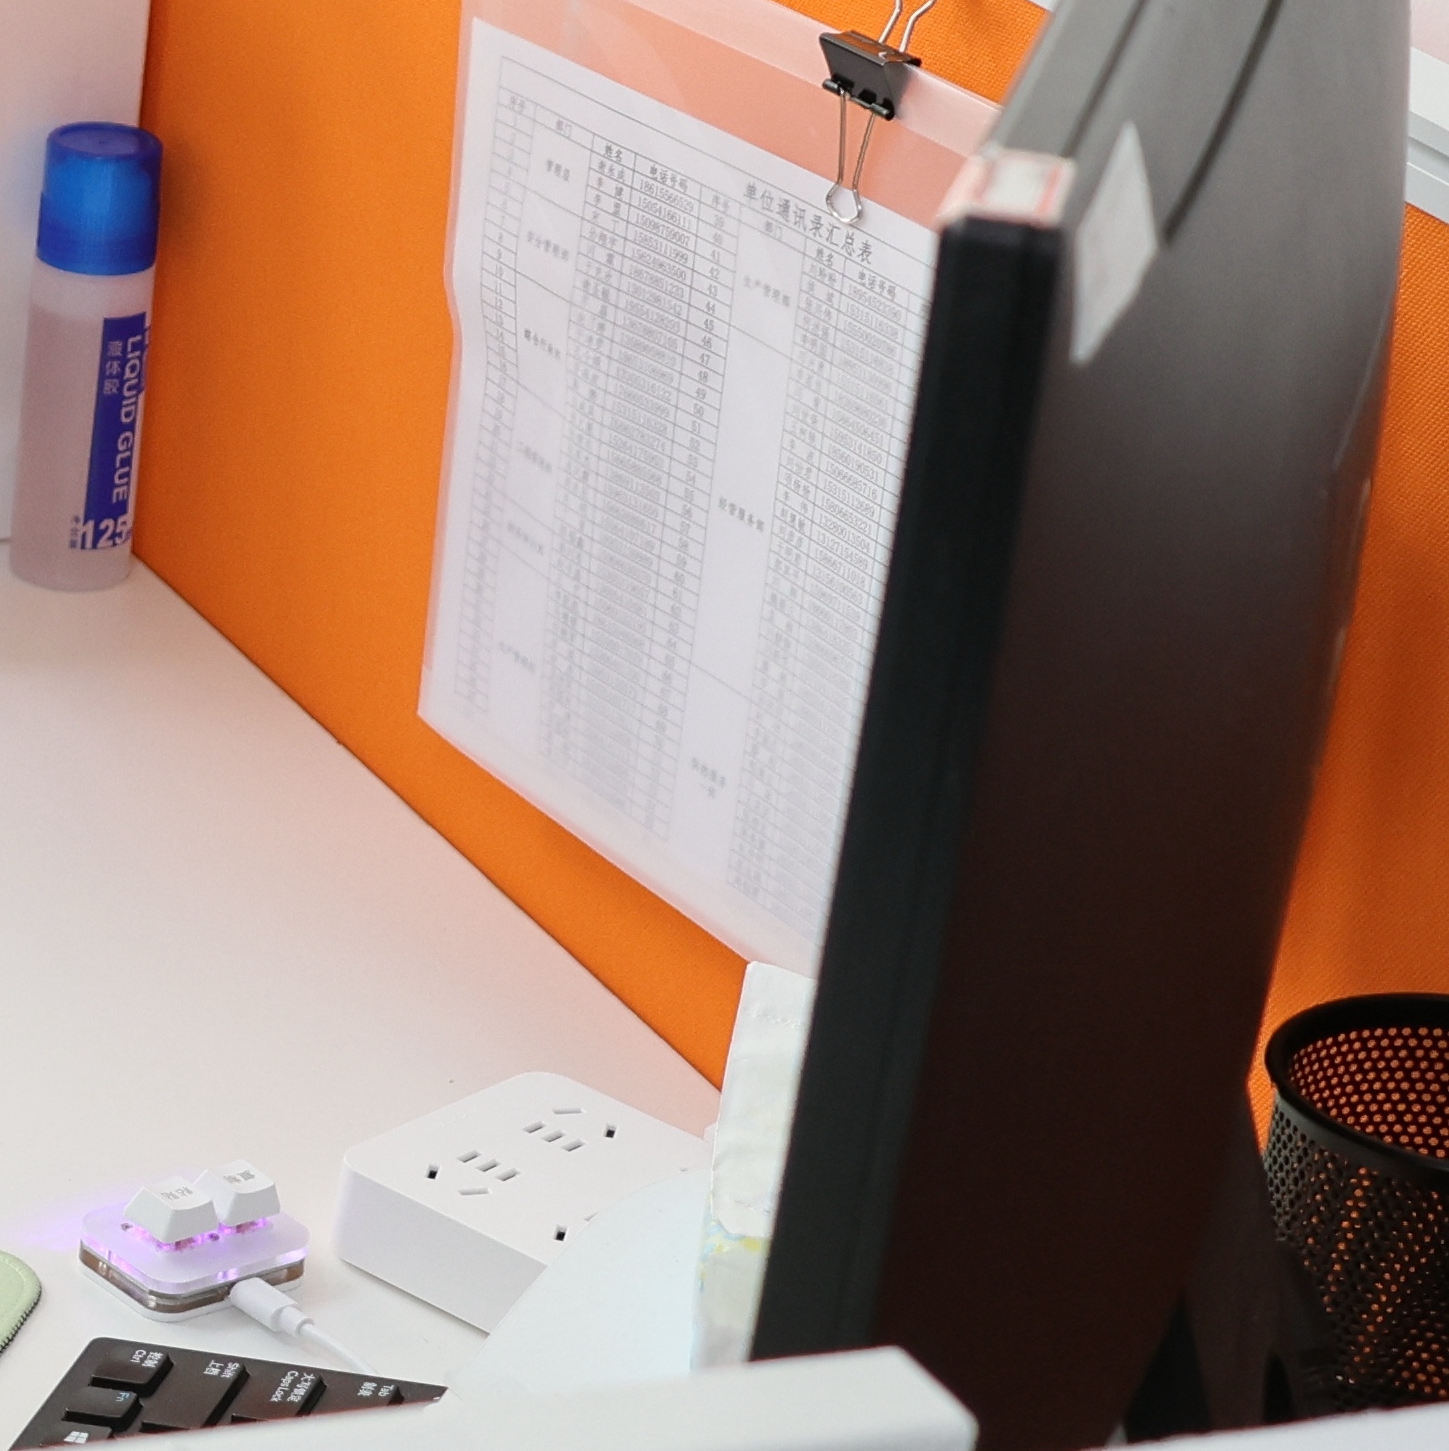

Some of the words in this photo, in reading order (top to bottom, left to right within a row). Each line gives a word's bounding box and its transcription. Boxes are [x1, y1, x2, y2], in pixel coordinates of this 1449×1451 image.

[742, 178, 874, 266] 单位通讯录汇总表
[648, 162, 688, 195] 电话号码
[856, 267, 897, 302] 电话号码
[708, 265, 720, 281] 42
[706, 282, 718, 298] 43
[704, 299, 716, 315] 44
[119, 335, 142, 424] LIQUID
[111, 430, 134, 504] GLUE
[130, 1349, 146, 1363] Ctrl
[142, 1352, 164, 1368] 控制
[220, 1362, 240, 1379] Shift
[280, 1370, 299, 1387] Caps
[115, 1392, 131, 1402] Fn
[270, 1386, 289, 1402] Lock
[377, 1384, 395, 1398] Tab
